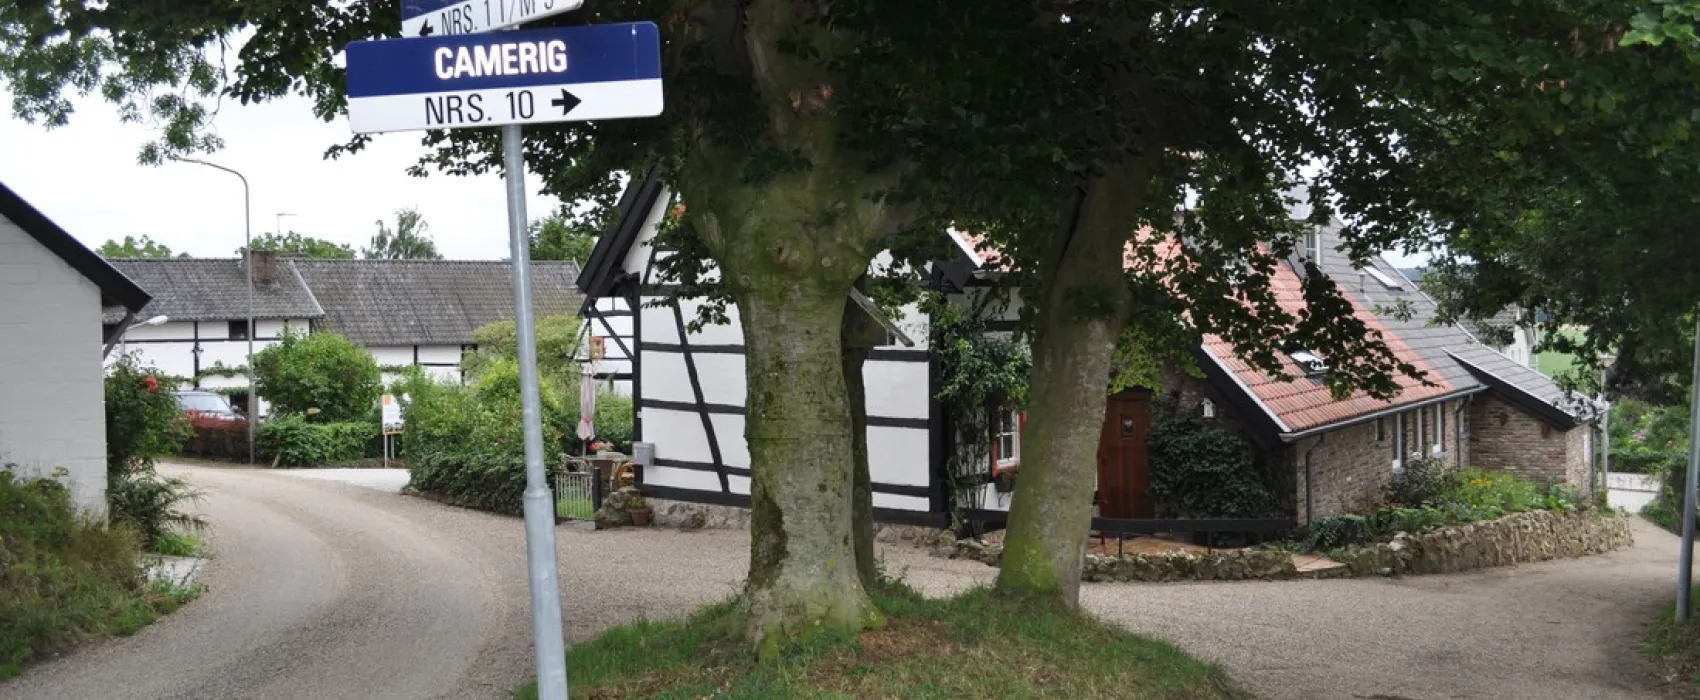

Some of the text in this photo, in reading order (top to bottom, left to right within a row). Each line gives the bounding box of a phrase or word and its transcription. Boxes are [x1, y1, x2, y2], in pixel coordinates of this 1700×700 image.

[441, 4, 478, 35] NRS.
[434, 39, 567, 79] CAMERIG
[424, 90, 534, 125] NRS. 10
